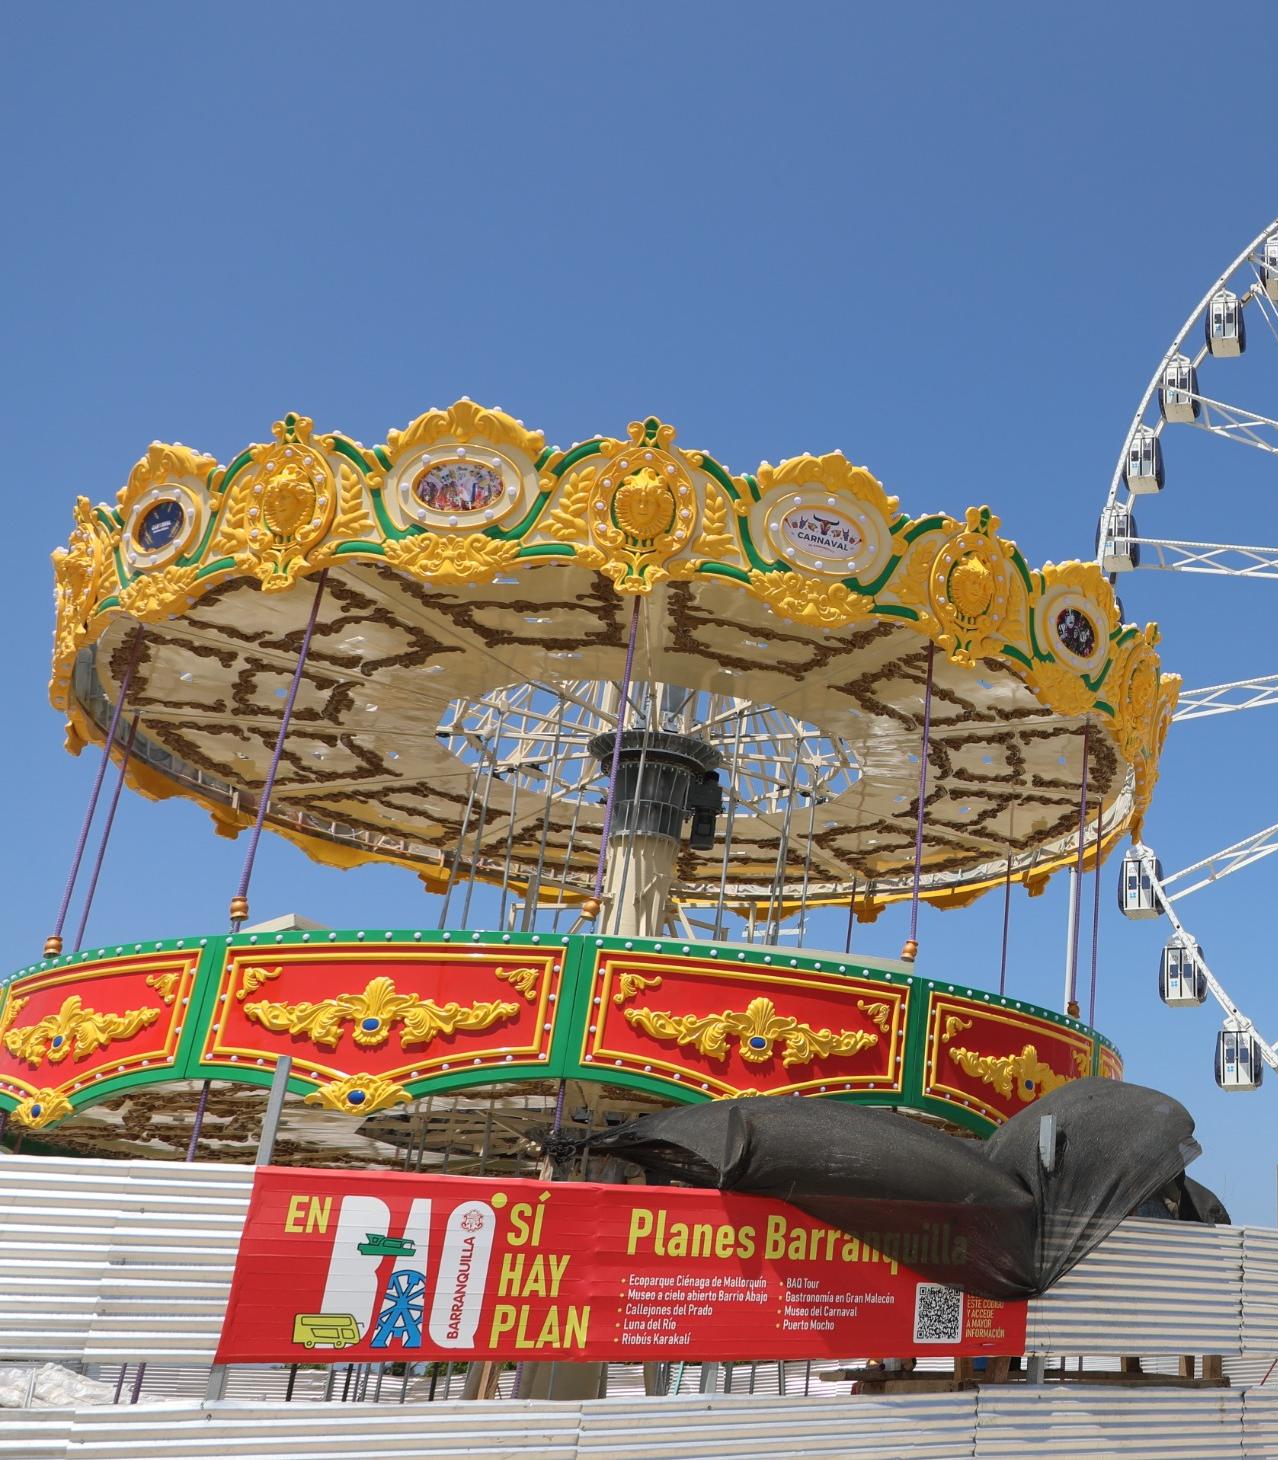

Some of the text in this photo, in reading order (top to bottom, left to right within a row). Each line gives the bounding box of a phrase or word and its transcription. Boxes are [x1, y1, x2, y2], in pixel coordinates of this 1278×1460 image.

[797, 531, 848, 551] CARNAVAL
[284, 1195, 333, 1234] EN
[506, 1190, 551, 1246] SÍ
[627, 1208, 756, 1259] Planes
[497, 1253, 571, 1297] HAY
[629, 1274, 767, 1290] Ecoparque Ciénaga de Mallorquín
[446, 1236, 476, 1339] BARRANQUILLA
[786, 1278, 820, 1289] BAQ Tour
[627, 1289, 768, 1304] Museo a cielo abierto Barrio Abajo
[785, 1291, 895, 1304] Gastronomía en Gran Malecón
[625, 1303, 713, 1318] Callejones del Prado
[784, 1305, 857, 1317] Museo del Carnaval
[967, 1299, 982, 1309] ESTE
[967, 1309, 994, 1319] Y ACCEDE
[488, 1304, 591, 1349] PLAN
[623, 1317, 676, 1330] Luna del Río
[783, 1319, 835, 1331] Puerto Mocho
[966, 1319, 992, 1329] A MAYOR
[621, 1332, 691, 1345] Riobús Karakalí
[965, 1327, 1005, 1338] INFORMACIÓN
